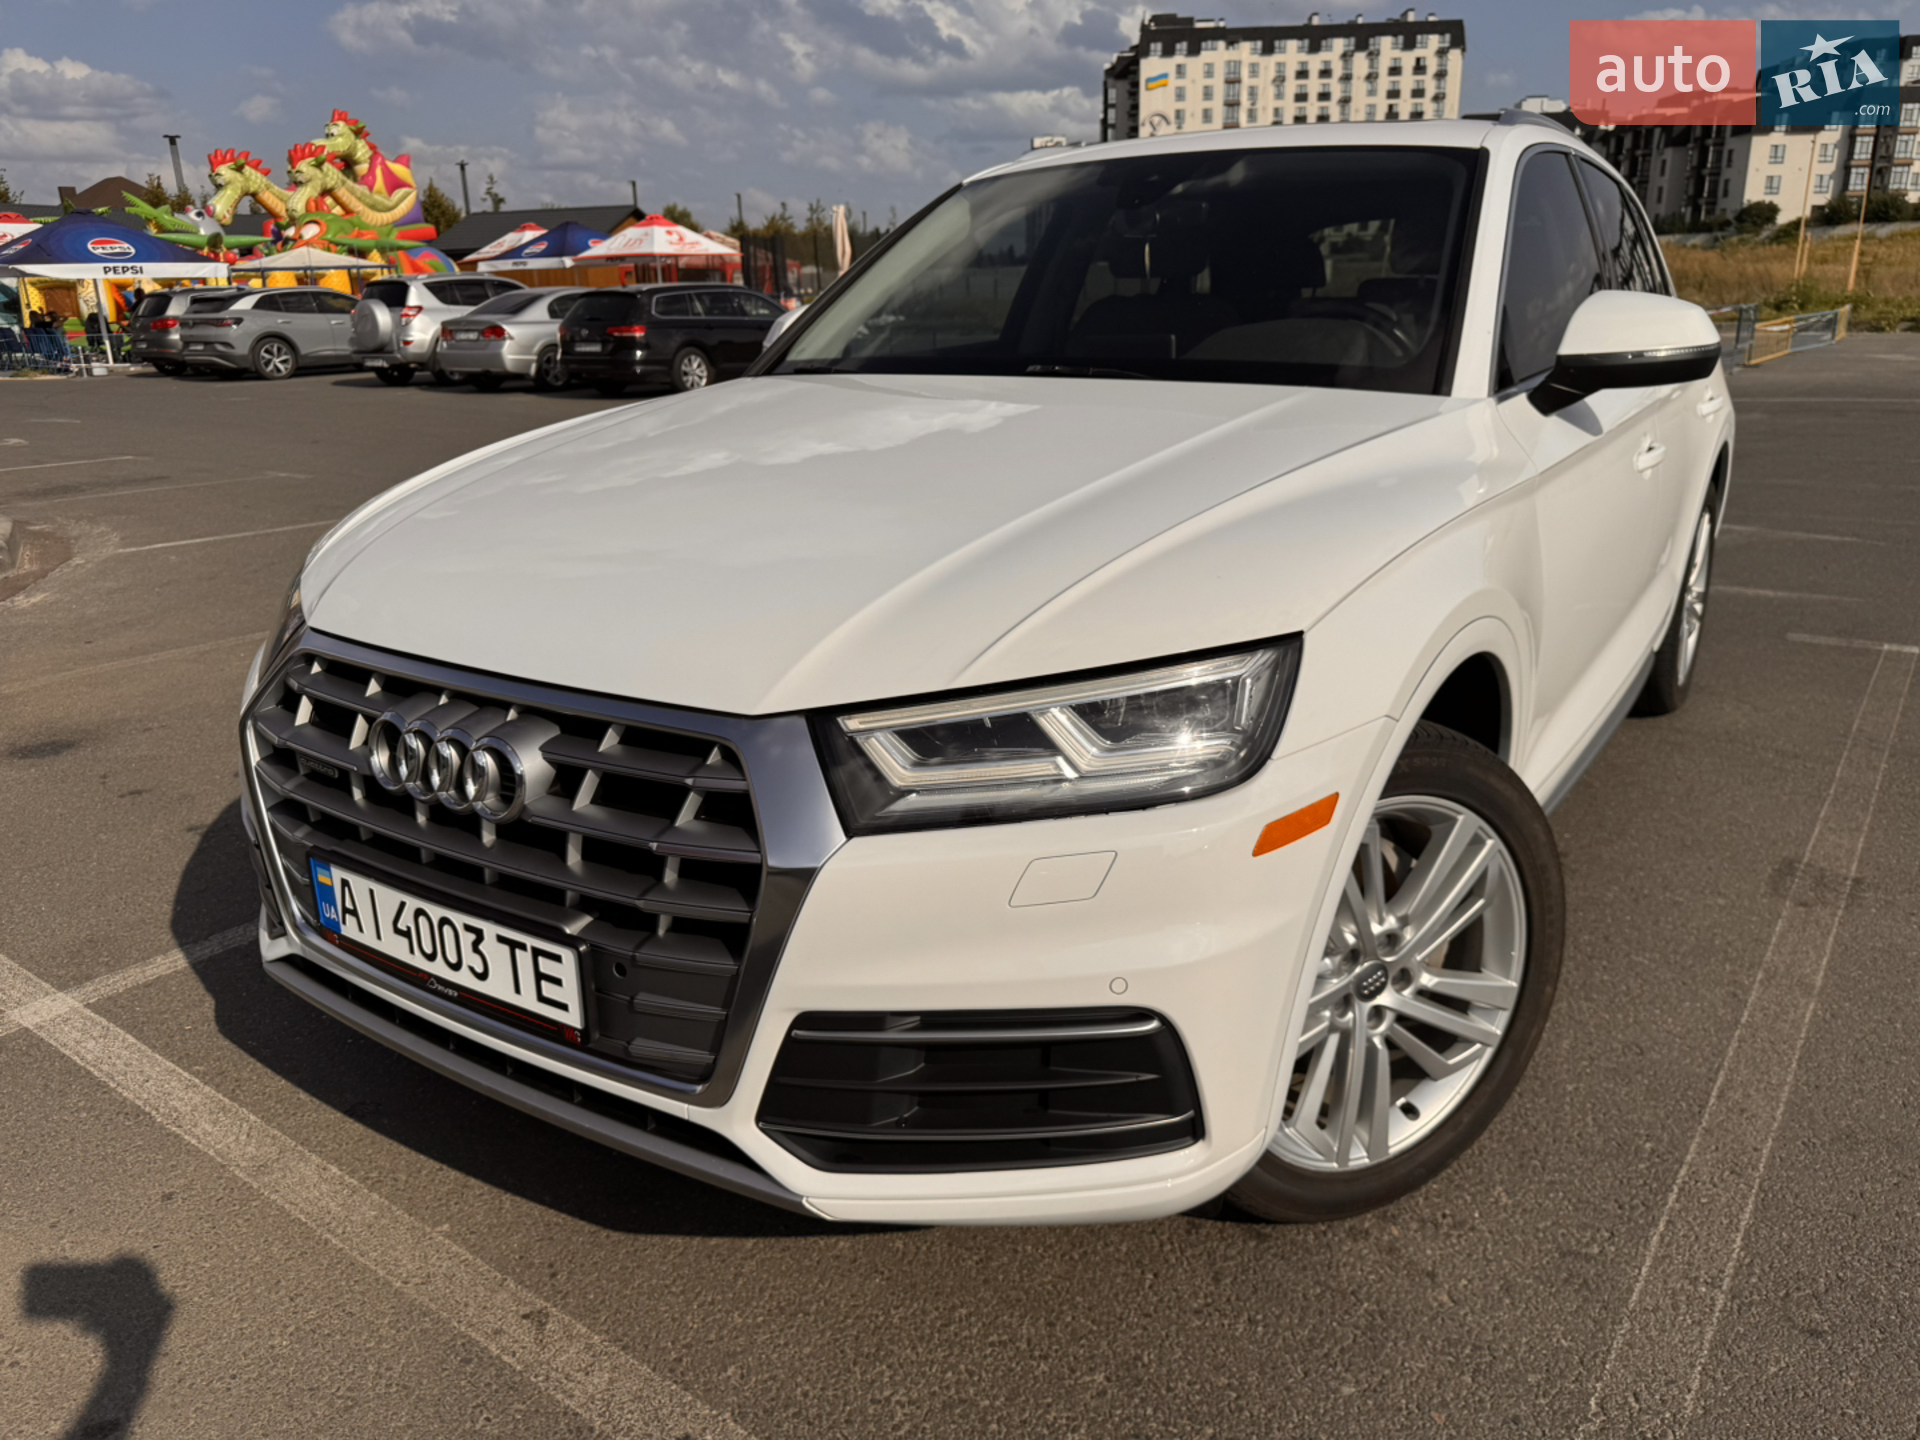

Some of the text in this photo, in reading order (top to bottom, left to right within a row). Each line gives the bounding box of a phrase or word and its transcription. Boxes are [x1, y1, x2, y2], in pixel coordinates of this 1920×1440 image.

[103, 266, 144, 275] PEPSI
[322, 902, 338, 921] UA
[340, 877, 570, 1013] AI 4003 TE
